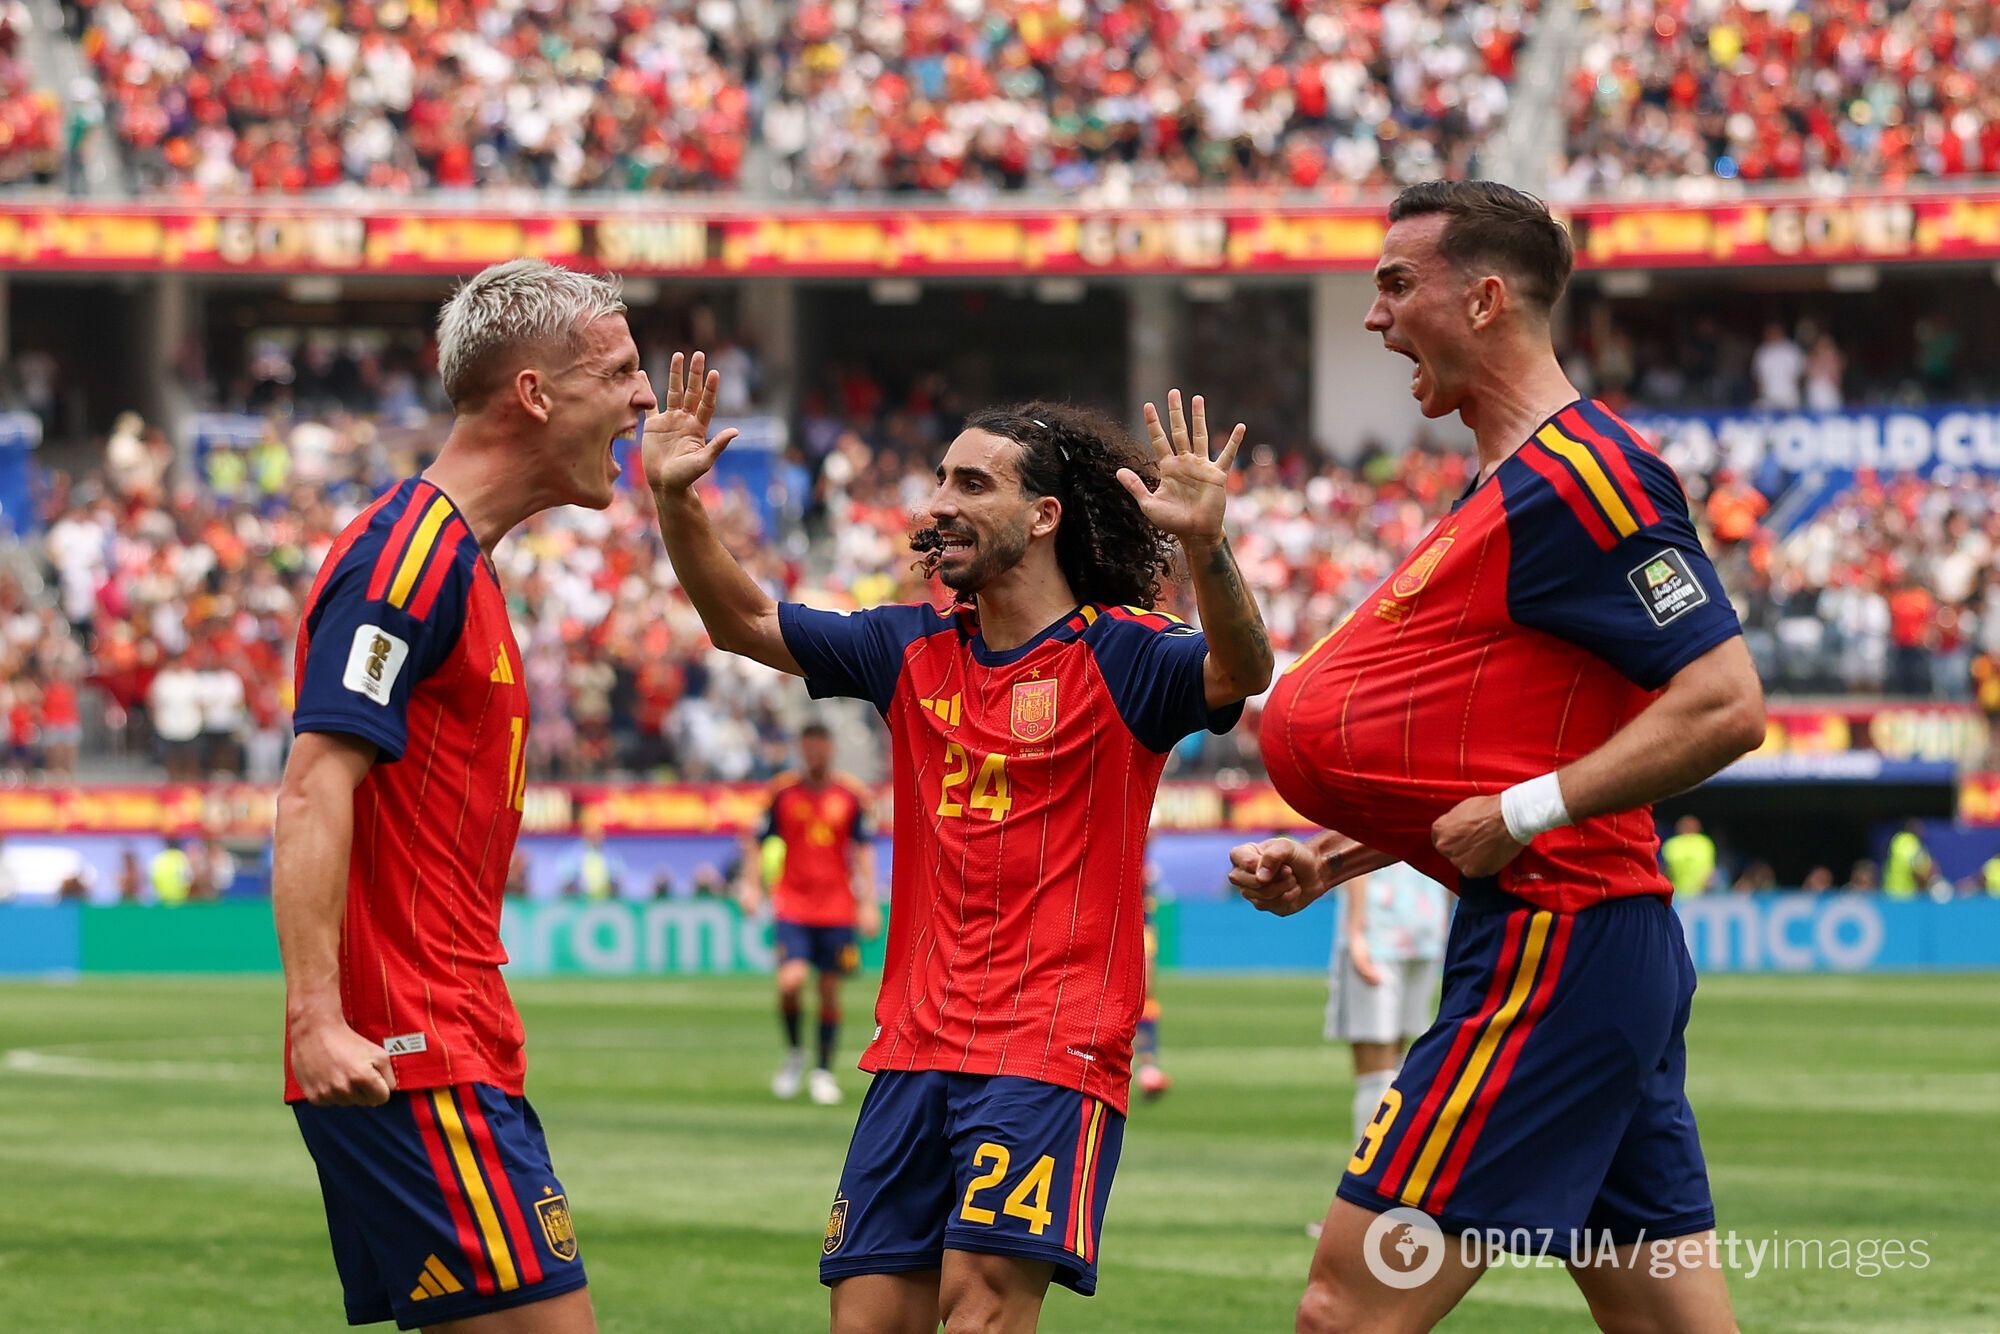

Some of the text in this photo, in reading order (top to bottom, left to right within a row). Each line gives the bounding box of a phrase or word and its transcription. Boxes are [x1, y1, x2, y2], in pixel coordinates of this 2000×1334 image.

[1718, 412, 1932, 472] WORLD
[936, 742, 1013, 821] 24
[959, 1142, 1055, 1235] 24
